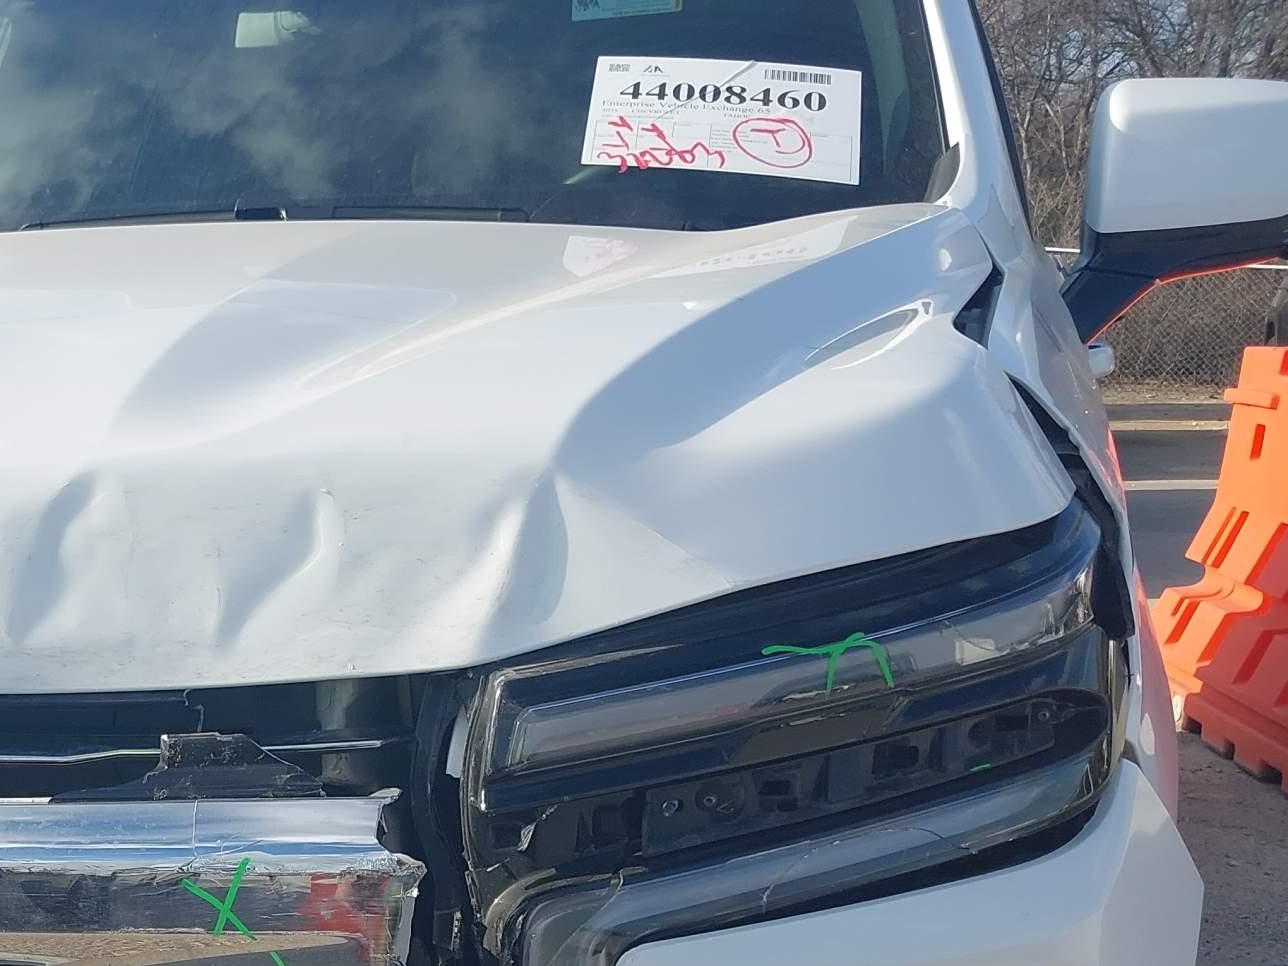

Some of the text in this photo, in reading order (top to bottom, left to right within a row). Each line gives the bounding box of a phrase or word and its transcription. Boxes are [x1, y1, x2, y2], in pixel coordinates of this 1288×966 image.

[602, 100, 655, 108] Enterprise
[702, 103, 754, 113] Exchange
[619, 80, 828, 112] 44008460
